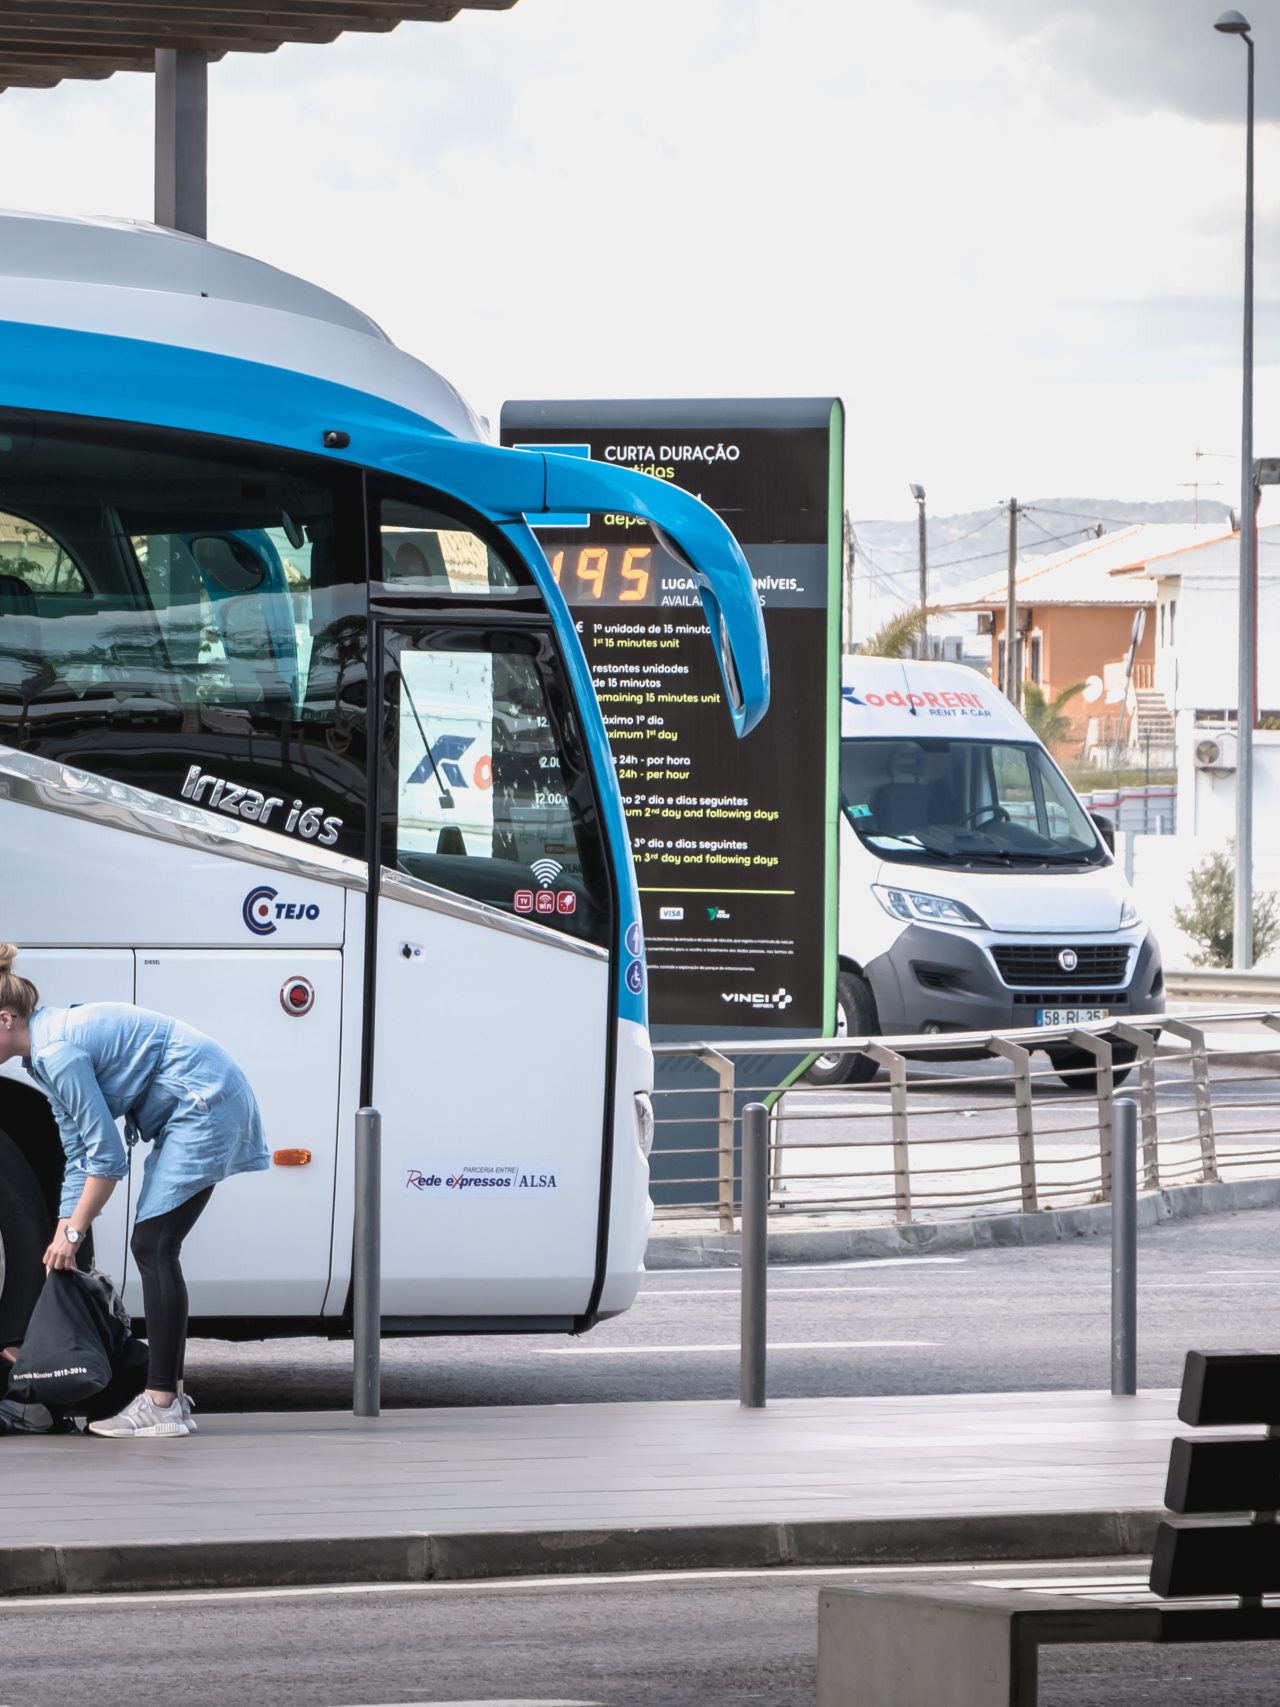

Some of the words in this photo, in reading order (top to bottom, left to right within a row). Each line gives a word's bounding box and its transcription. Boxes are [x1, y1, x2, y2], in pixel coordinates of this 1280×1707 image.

[604, 445, 656, 461] CURTA
[659, 443, 740, 464] DURAÇÃO
[605, 623, 646, 634] unidade
[648, 623, 661, 635] de
[663, 624, 673, 635] 15
[675, 624, 711, 635] minuto
[605, 638, 615, 648] 15
[617, 638, 659, 649] minutes
[660, 638, 680, 649] unit
[592, 664, 640, 673] restantes
[642, 664, 689, 674] unidades
[592, 678, 606, 687] de
[608, 678, 618, 688] 15
[620, 679, 661, 688] minutos
[597, 692, 643, 704] emaining
[646, 693, 655, 702] 15
[657, 693, 698, 703] minutes
[701, 693, 720, 703] unit
[929, 708, 956, 717] RENT
[970, 709, 991, 717] CAR
[603, 715, 634, 725] áximo
[647, 715, 664, 725] dia
[658, 730, 678, 742] day
[619, 755, 638, 765] 24h
[647, 757, 664, 766] por
[666, 755, 690, 766] hora
[619, 769, 638, 779] 24h
[646, 771, 664, 780] per
[666, 770, 690, 779] hour
[180, 764, 284, 824] Irizar
[284, 799, 344, 846] i6s
[648, 795, 664, 805] dia
[667, 797, 673, 805] e
[676, 796, 697, 805] dias
[699, 796, 749, 807] seguintes
[661, 808, 681, 819] day
[684, 809, 703, 818] and
[705, 809, 751, 820] following
[753, 810, 779, 821] days
[648, 838, 664, 848] dia
[666, 840, 673, 848] e
[675, 839, 697, 848] dias
[699, 839, 748, 851] seguintes
[661, 854, 681, 865] day
[683, 854, 703, 864] and
[705, 854, 751, 866] following
[753, 855, 778, 866] days
[275, 903, 320, 921] TEJO
[722, 993, 769, 1003] VINCI
[463, 1166, 494, 1174] PARCERIA
[495, 1166, 516, 1174] ENTRE
[406, 1169, 442, 1191] Rede
[518, 1175, 557, 1188] ALSA
